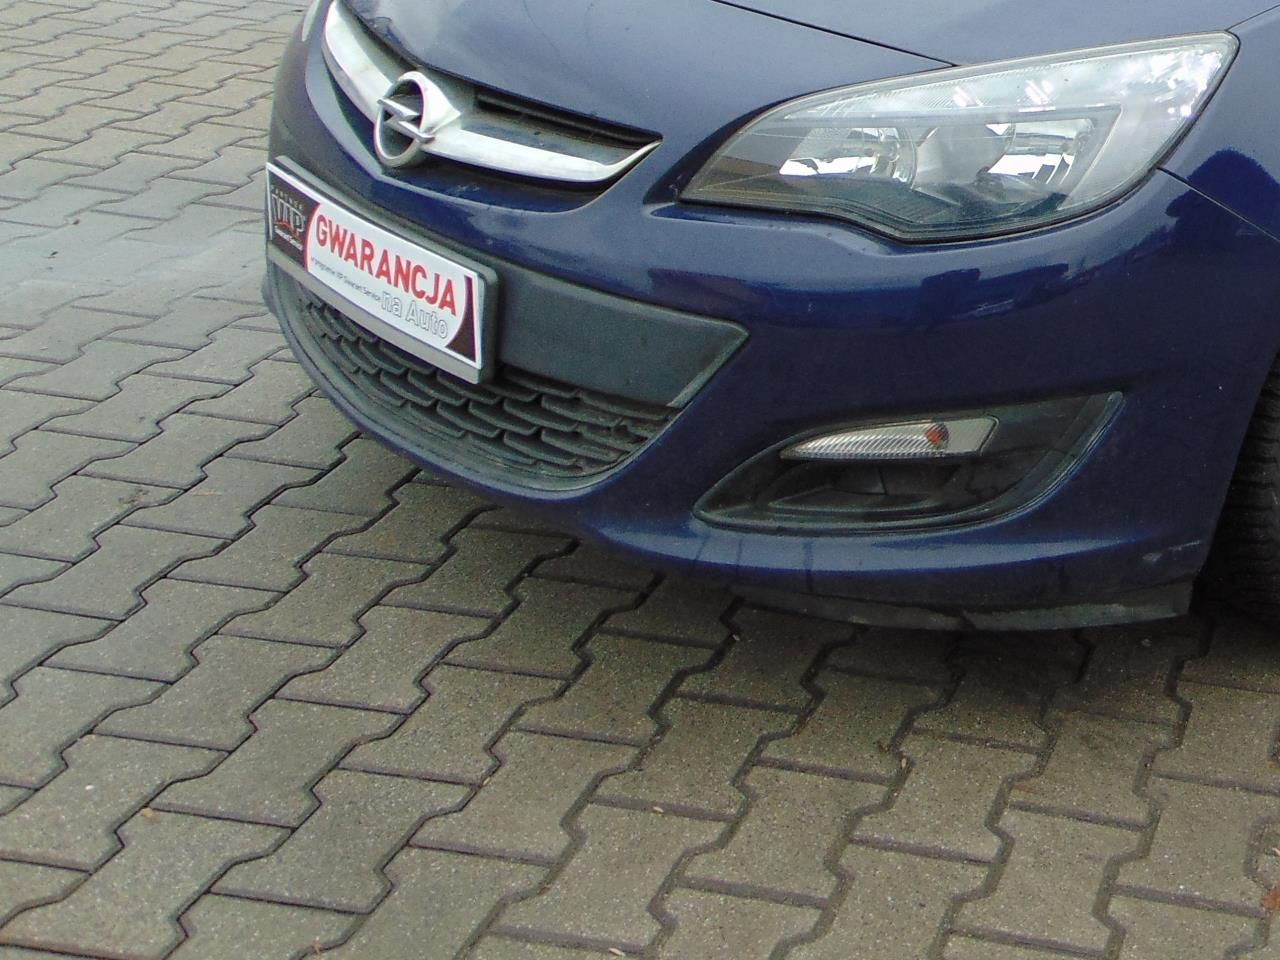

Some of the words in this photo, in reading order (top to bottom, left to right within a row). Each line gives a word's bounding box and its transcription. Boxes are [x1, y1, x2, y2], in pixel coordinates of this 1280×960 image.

[315, 213, 457, 317] GWARANCJA
[381, 290, 403, 318] na
[405, 299, 449, 340] Auto
